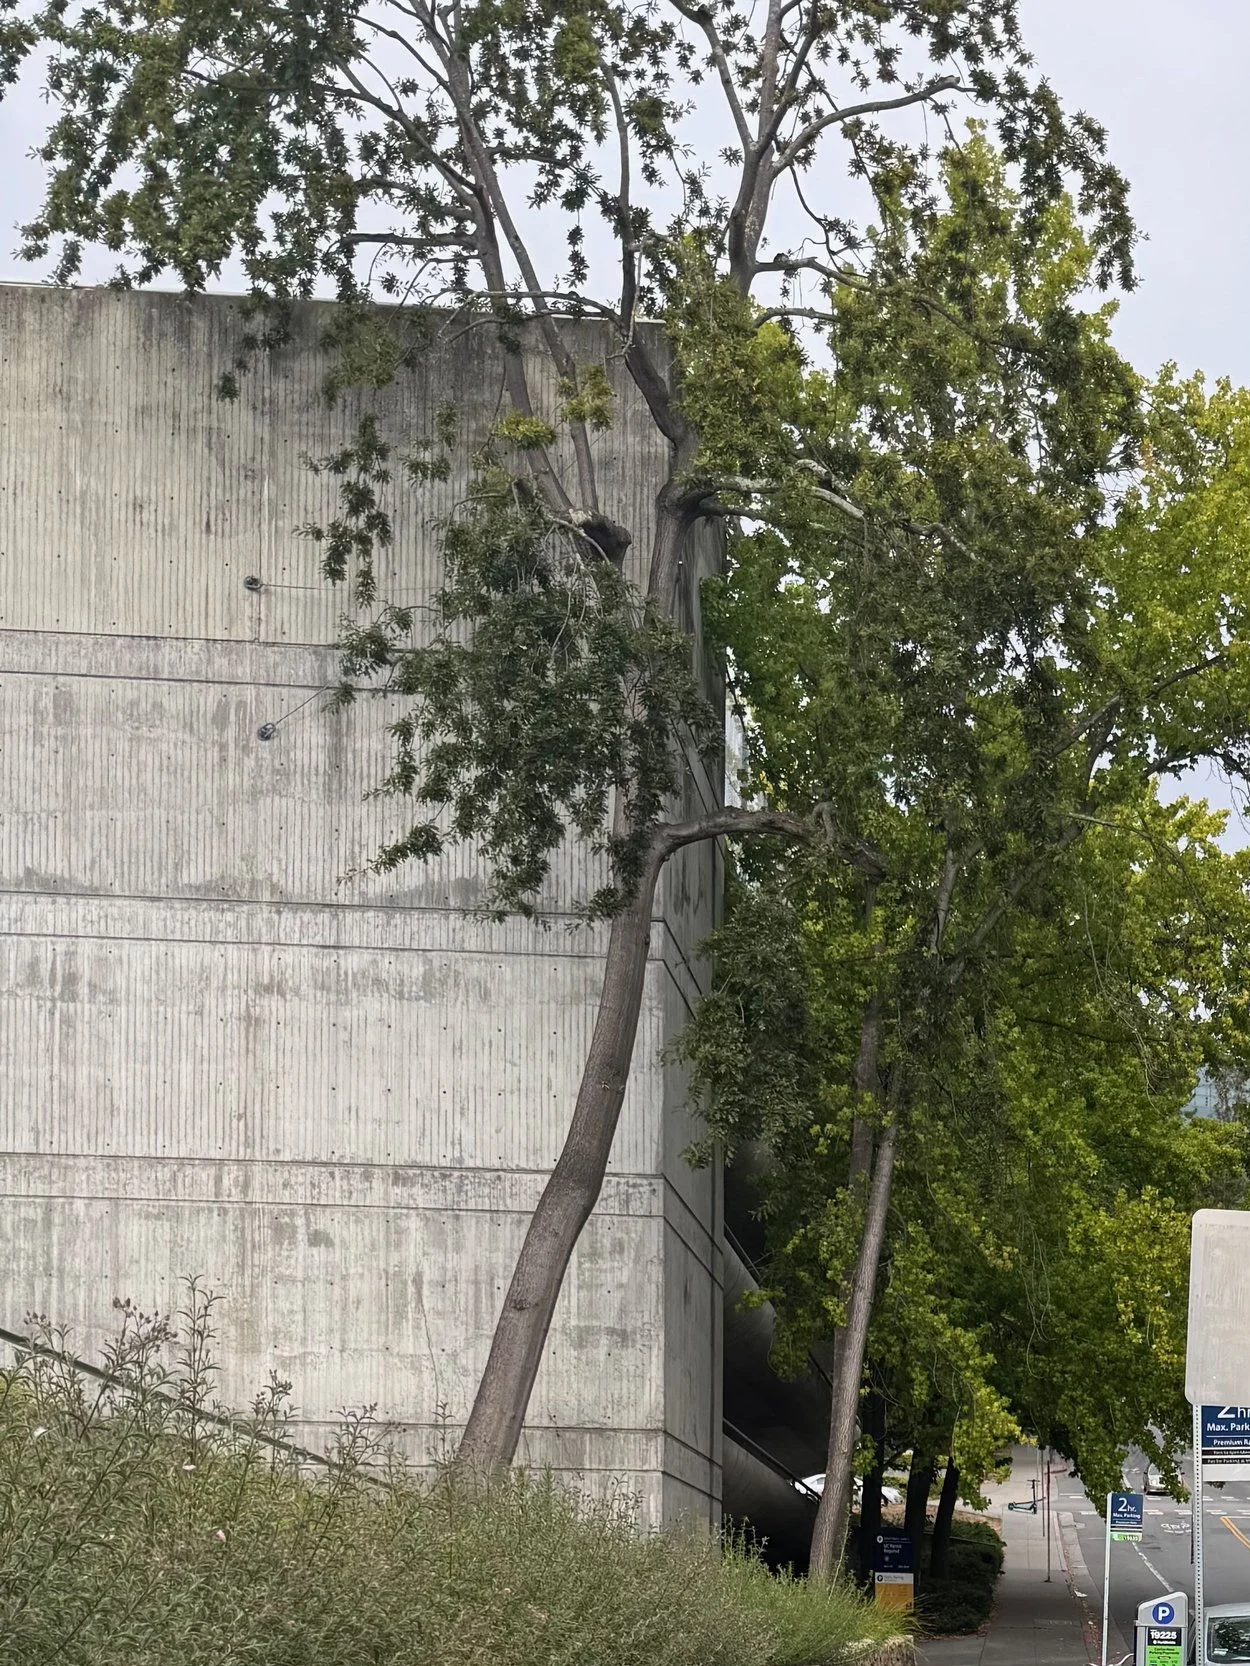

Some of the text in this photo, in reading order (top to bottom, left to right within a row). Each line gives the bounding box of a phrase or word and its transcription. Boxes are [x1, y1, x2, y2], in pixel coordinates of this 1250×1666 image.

[1207, 1423, 1229, 1432] Max.
[1117, 1497, 1128, 1512] 2
[1158, 1606, 1171, 1621] P
[1150, 1631, 1177, 1639] 19225
